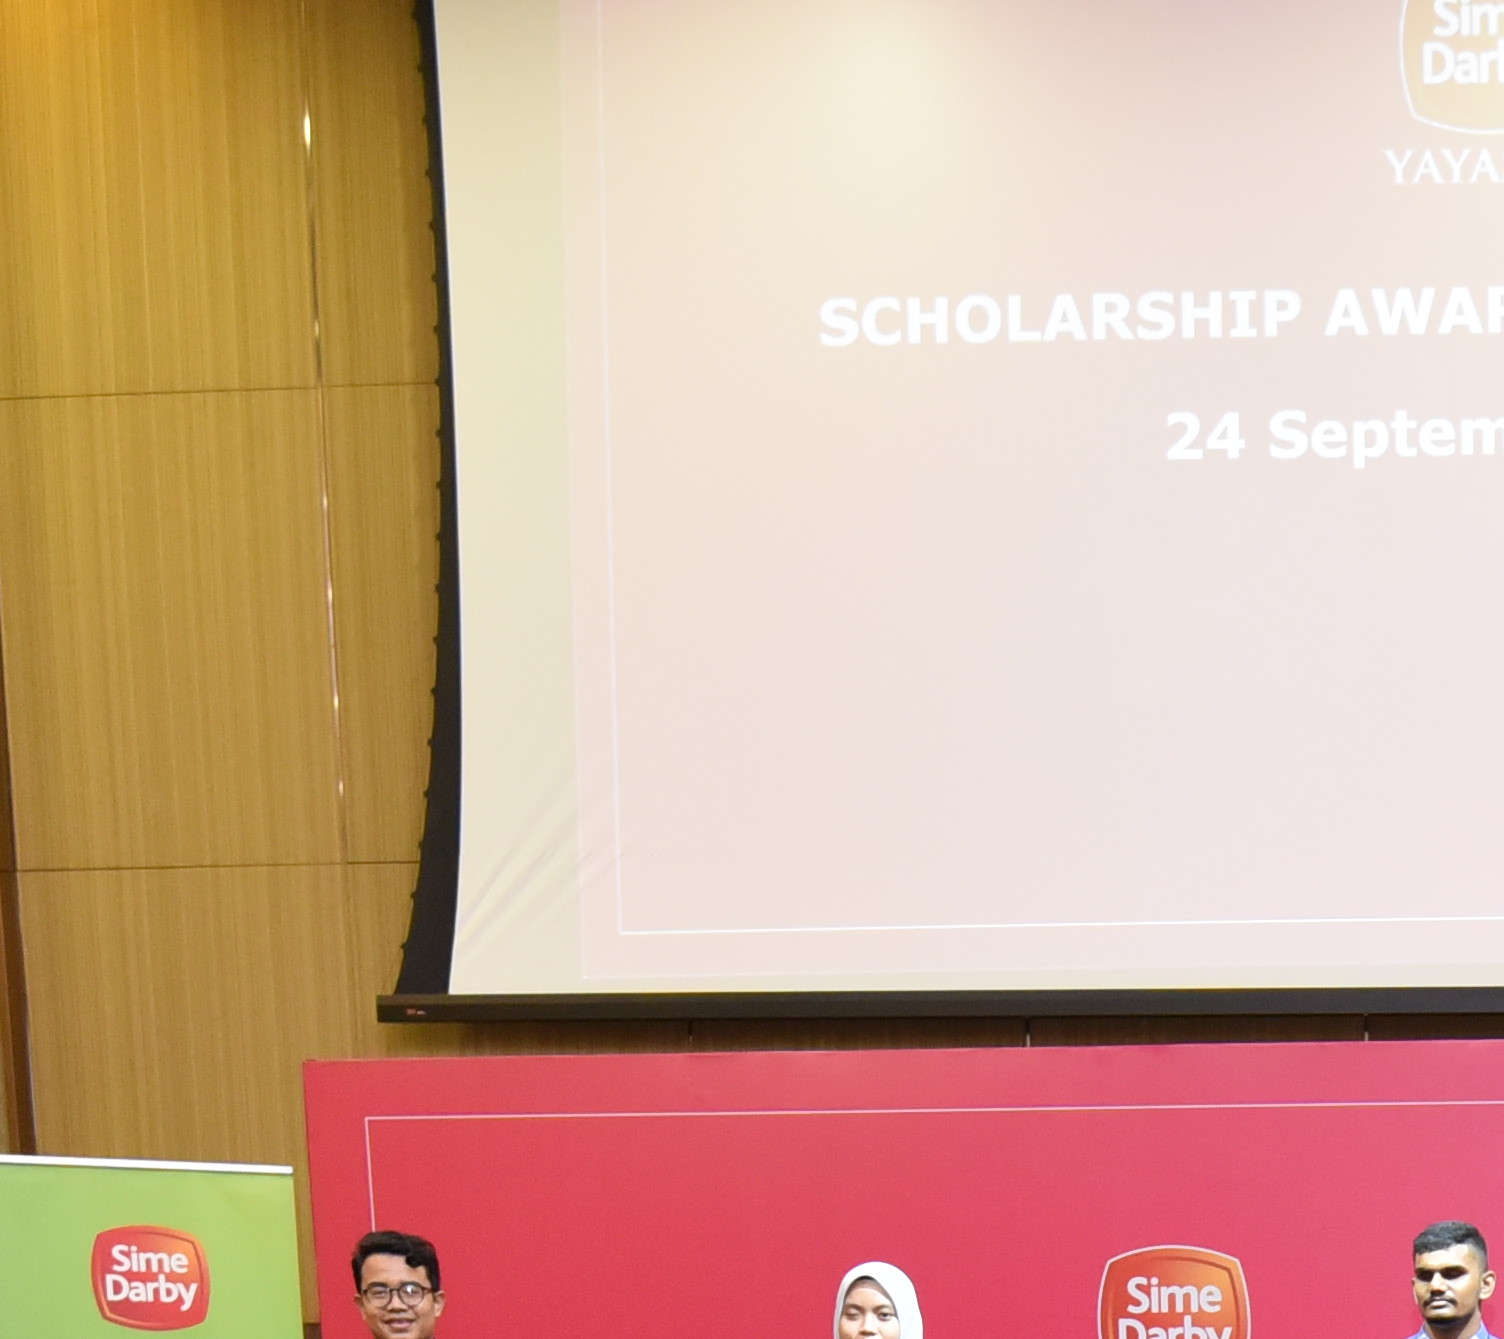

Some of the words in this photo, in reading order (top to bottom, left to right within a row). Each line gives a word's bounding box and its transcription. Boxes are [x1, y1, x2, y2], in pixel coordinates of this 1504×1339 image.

[819, 289, 1302, 347] SCHOLARSHIP
[1166, 411, 1246, 460] 24
[112, 1244, 189, 1274] Sime
[105, 1273, 199, 1312] Darby
[1126, 1276, 1223, 1314] Sime
